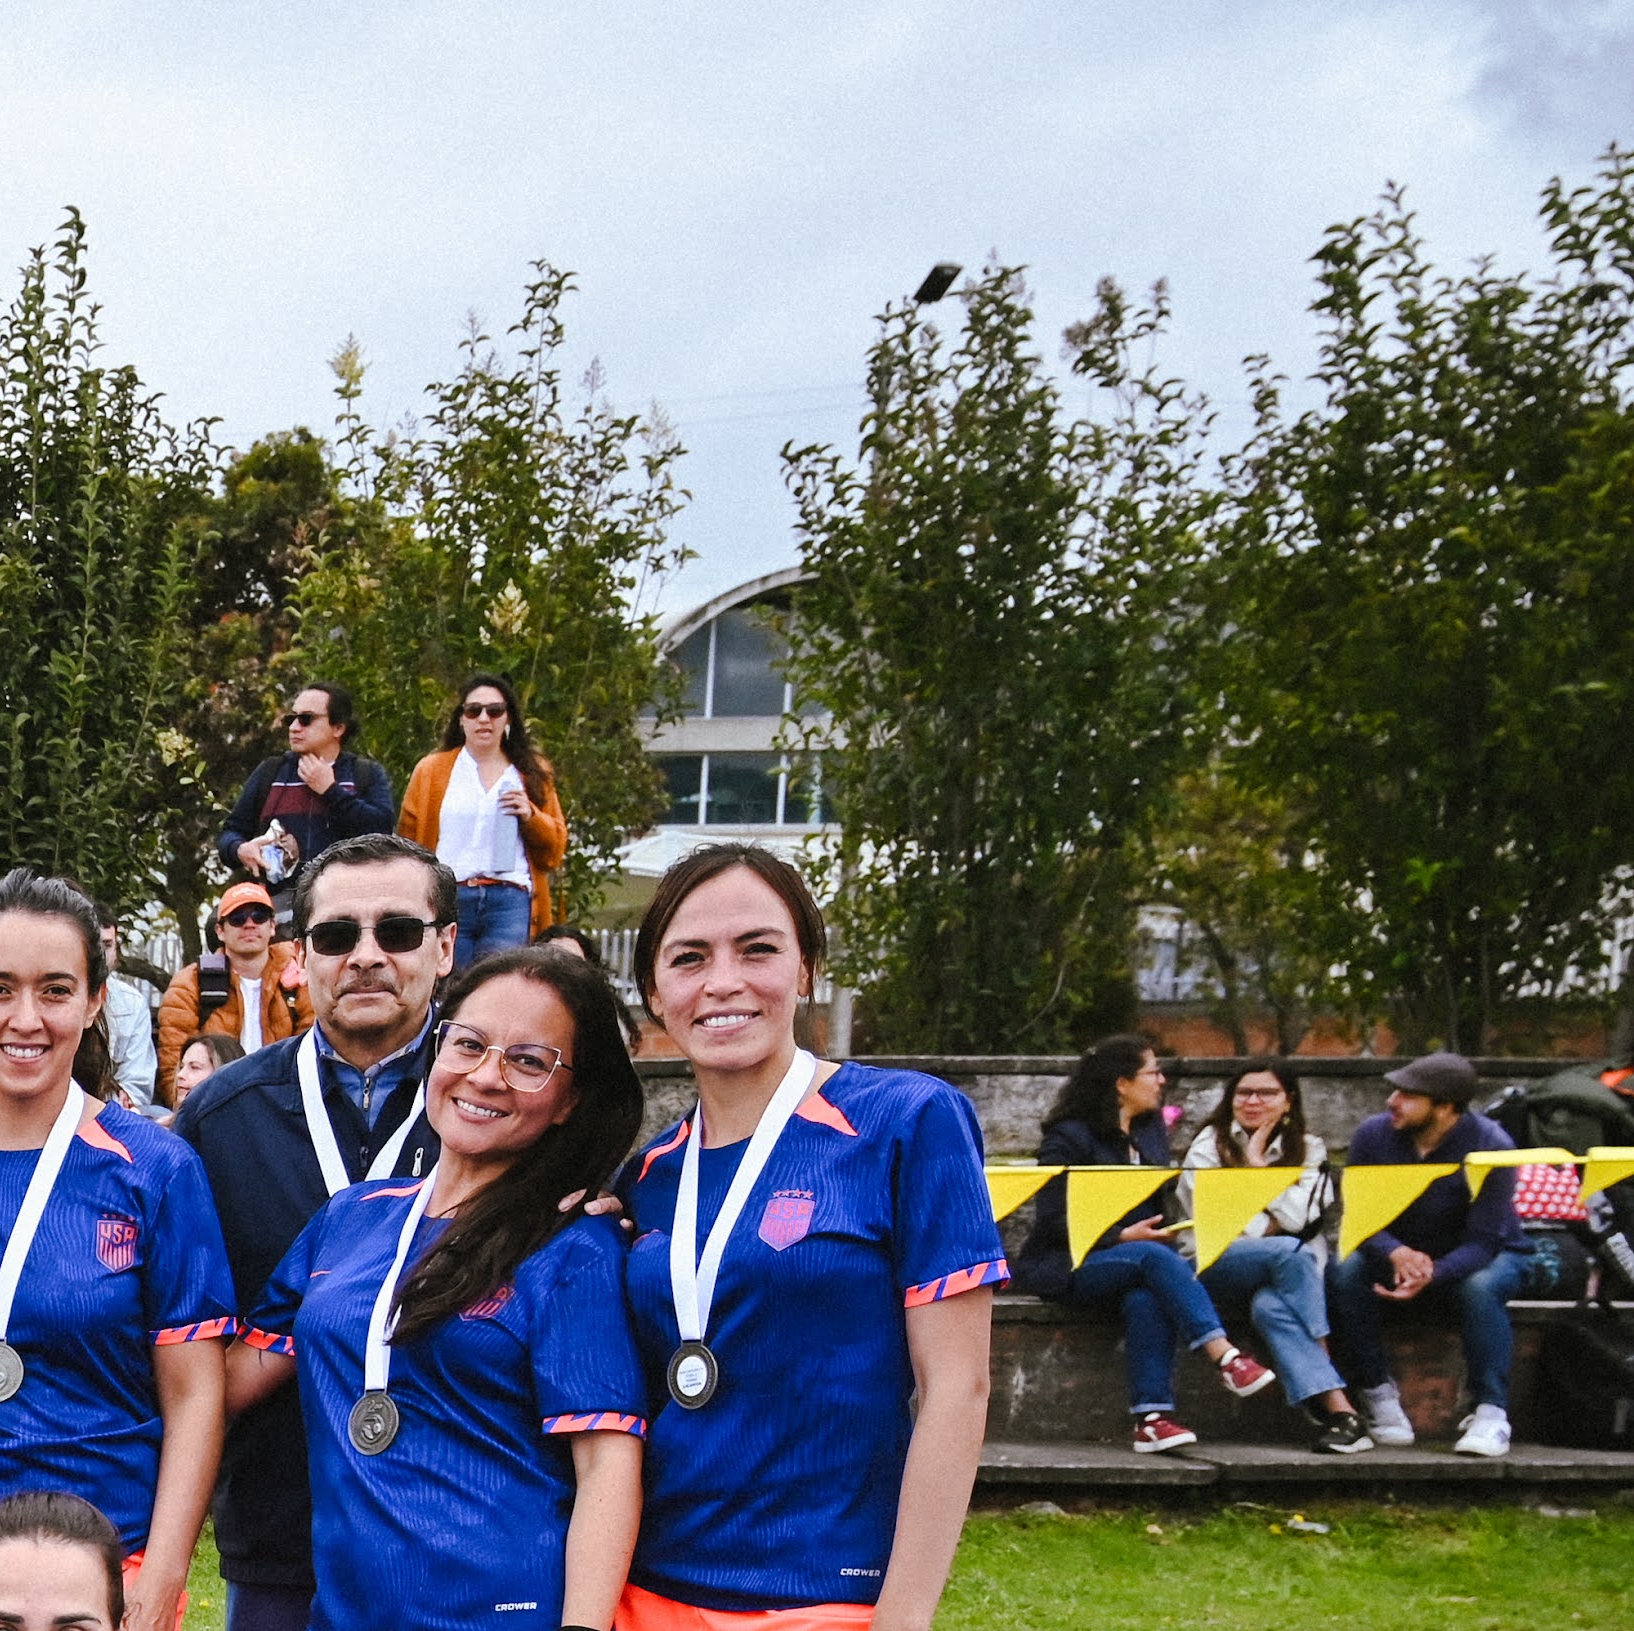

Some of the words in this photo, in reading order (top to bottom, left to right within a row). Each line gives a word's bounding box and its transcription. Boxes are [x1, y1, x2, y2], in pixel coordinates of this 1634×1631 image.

[769, 1200, 810, 1219] USA
[100, 1223, 135, 1245] USA
[840, 1567, 881, 1577] CROWER
[494, 1601, 538, 1612] CROWER
